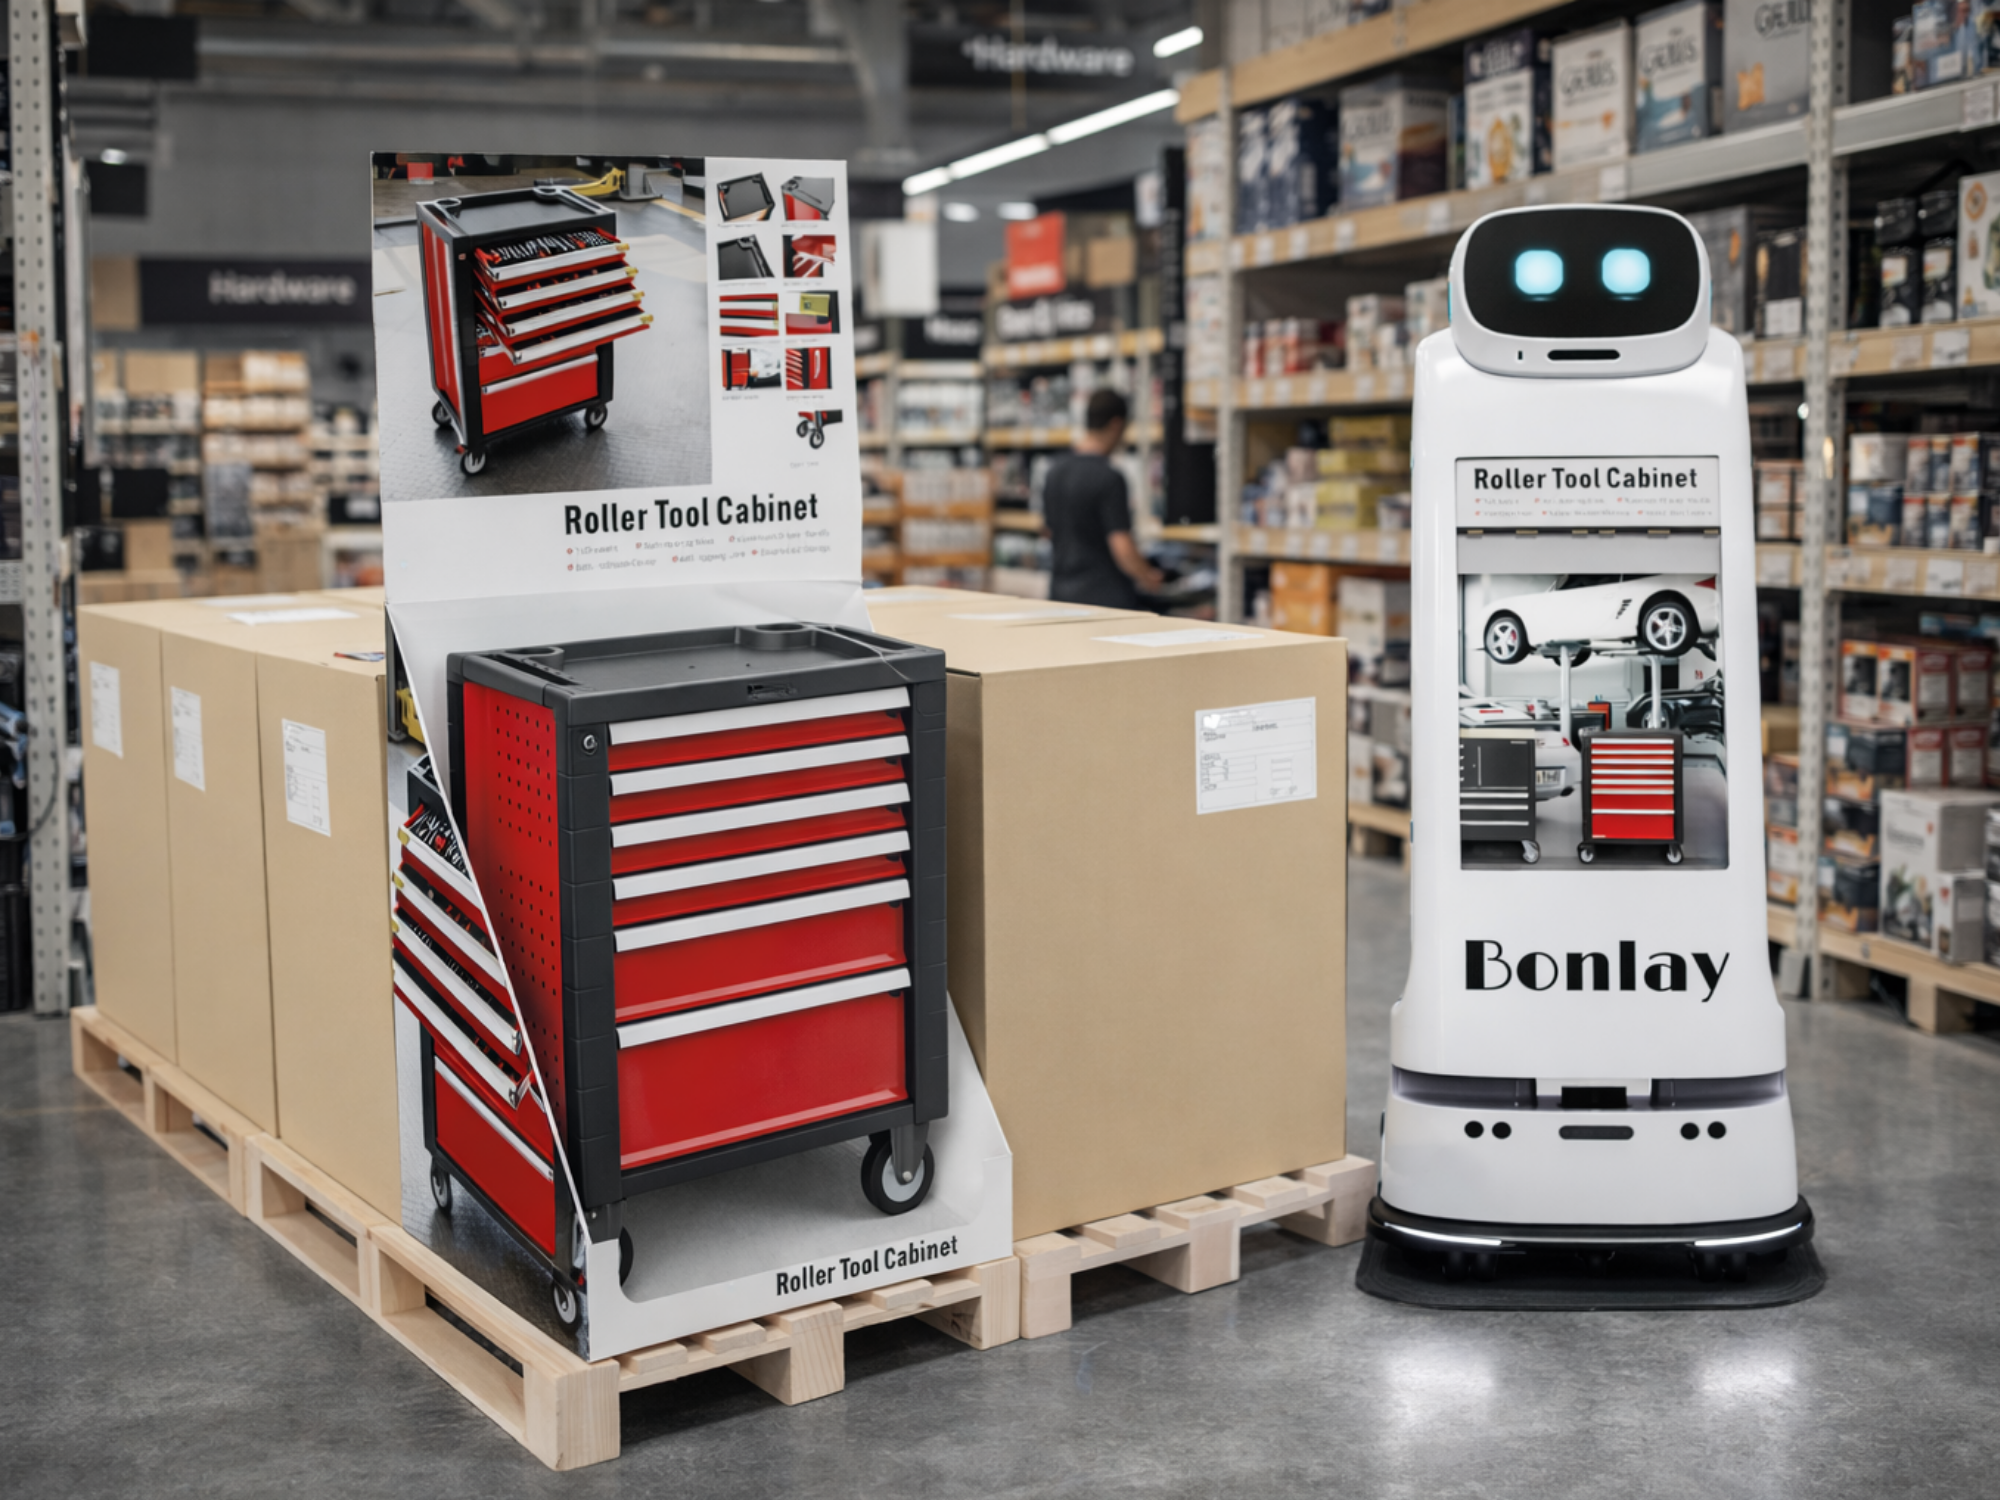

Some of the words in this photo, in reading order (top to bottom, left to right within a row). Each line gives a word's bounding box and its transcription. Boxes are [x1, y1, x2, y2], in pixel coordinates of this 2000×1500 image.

[209, 269, 355, 305] Hardware
[1474, 468, 1546, 489] Roller
[1552, 467, 1600, 489] Tool
[1606, 467, 1698, 488] Cabinet
[564, 502, 648, 535] Roller
[654, 496, 709, 529] Tool
[716, 493, 818, 525] Cabinet
[1465, 939, 1730, 1002] Bonlay
[776, 1265, 836, 1296] Roller
[839, 1250, 879, 1280] Tool
[884, 1235, 958, 1270] Cabinet
